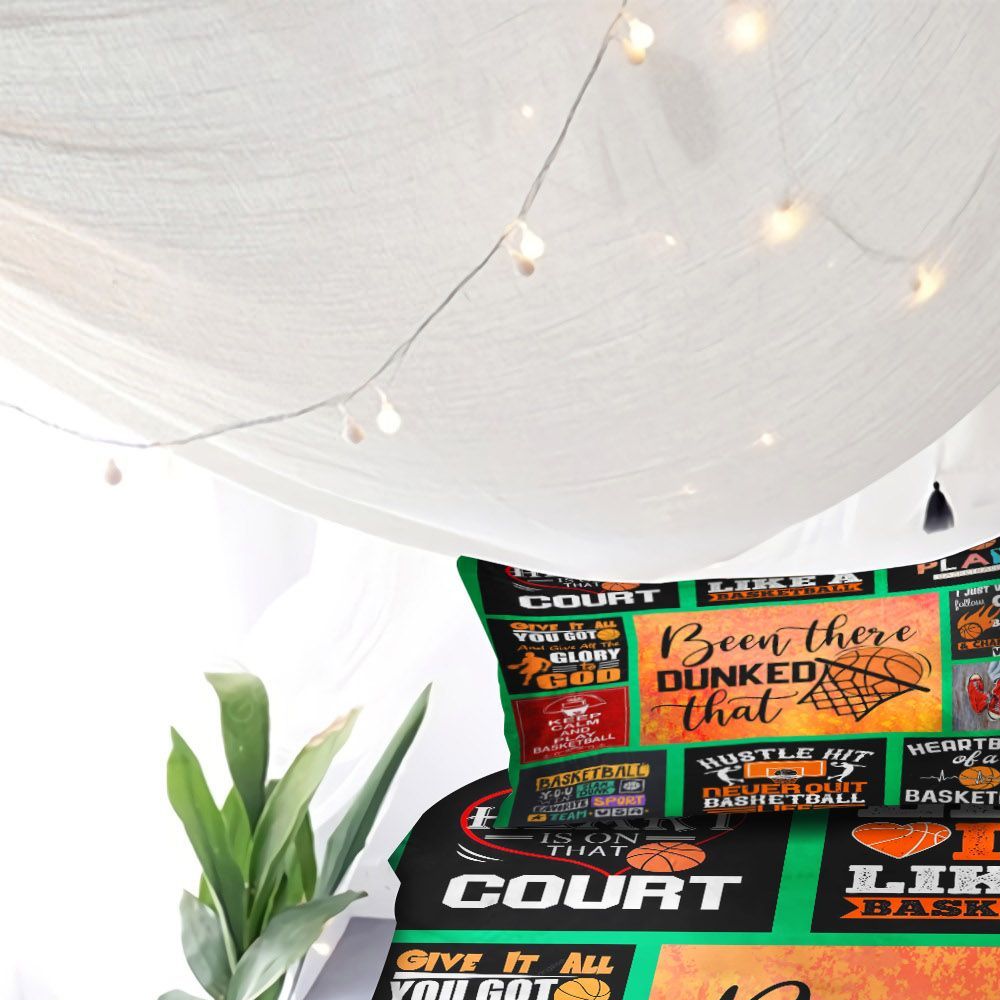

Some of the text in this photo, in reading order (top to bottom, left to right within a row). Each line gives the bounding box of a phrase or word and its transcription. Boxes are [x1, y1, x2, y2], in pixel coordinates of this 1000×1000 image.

[708, 573, 863, 593] LIKE A
[519, 589, 661, 610] COURT
[964, 586, 990, 597] JUST
[954, 598, 985, 611] follow
[513, 630, 597, 643] YOU GOT
[661, 613, 918, 667] Been there
[549, 648, 621, 664] GLORY
[536, 668, 621, 690] GOD
[656, 661, 816, 692] DUNKED
[651, 687, 798, 731] that
[548, 712, 602, 726] KEEP
[551, 719, 600, 731] CALM
[560, 726, 591, 736] AND
[533, 733, 616, 754] BASKETBALL
[696, 747, 875, 770] HUSTLE HIT
[952, 750, 1000, 767] of a
[540, 763, 646, 789] BASKETBALL
[805, 782, 868, 795] QUIT
[593, 795, 645, 807] SPORT
[703, 793, 866, 808] BASKETBALL
[550, 810, 588, 821] TEAM
[539, 832, 640, 844] IS ON
[547, 845, 629, 858] THAT
[442, 874, 743, 911] COURT
[396, 949, 484, 972] GIVE
[559, 952, 615, 974] ALL
